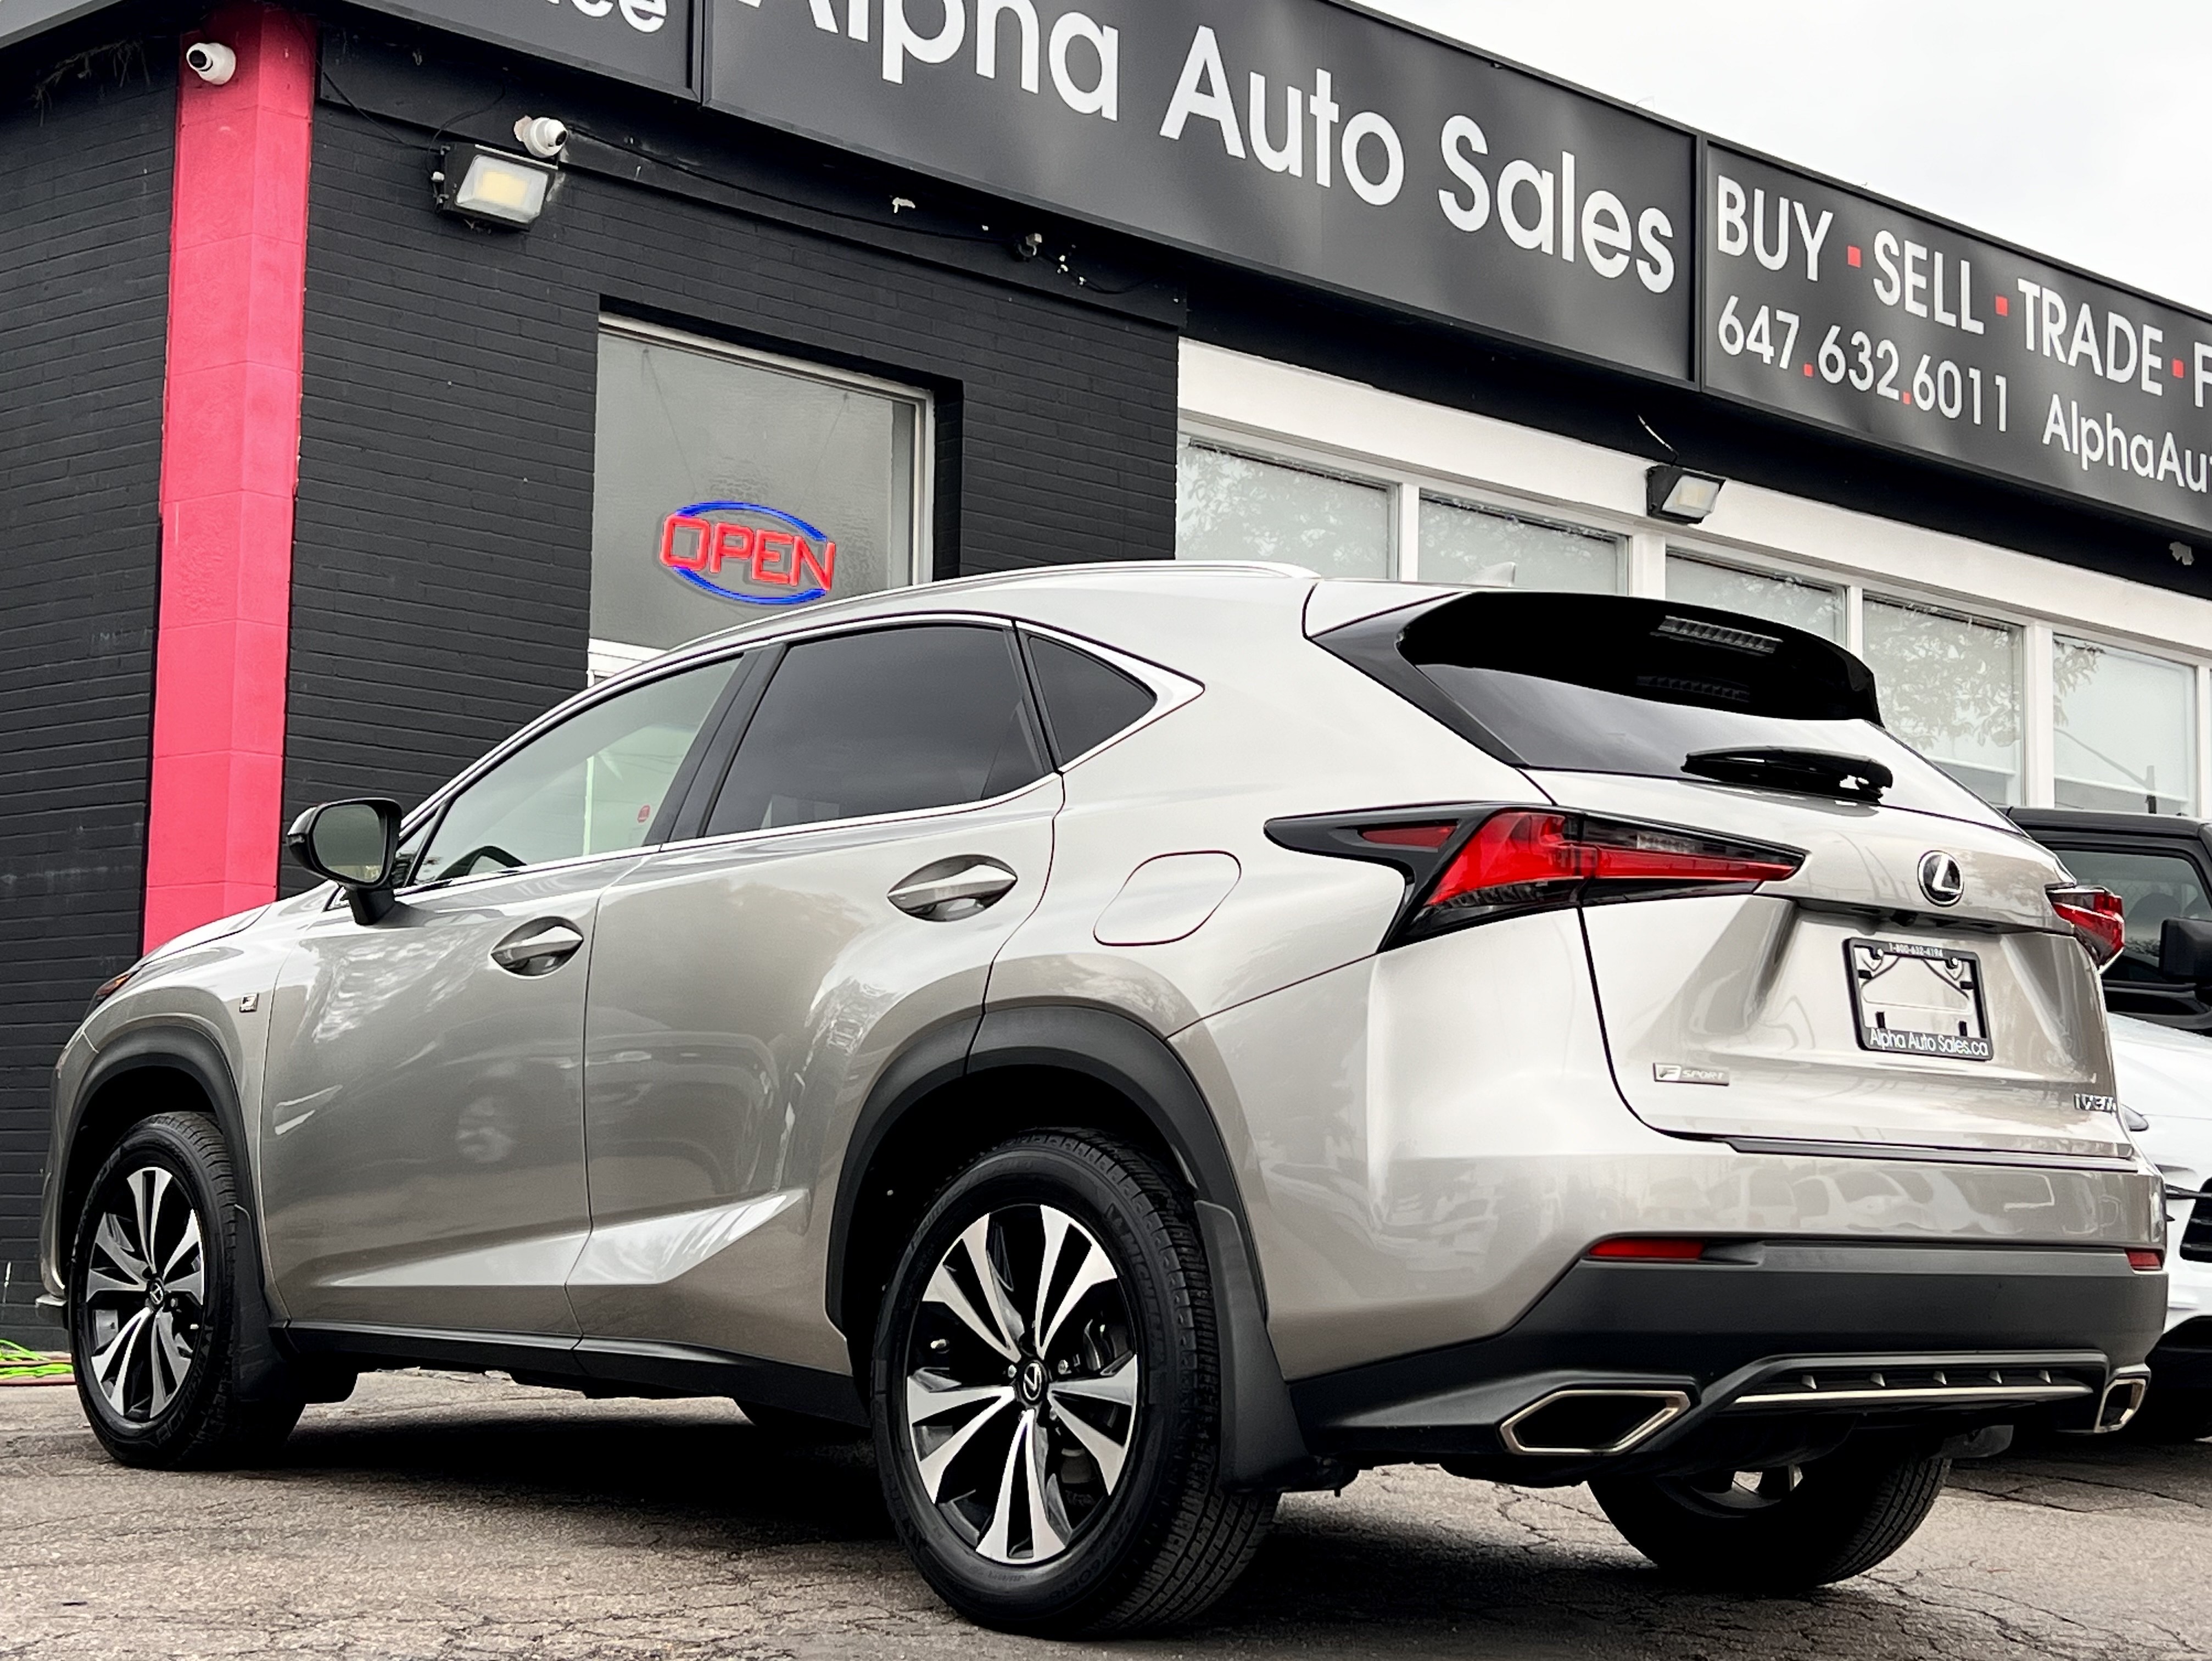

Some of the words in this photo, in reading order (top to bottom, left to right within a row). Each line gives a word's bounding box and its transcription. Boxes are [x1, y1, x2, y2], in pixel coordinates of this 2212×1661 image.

[737, 0, 1118, 122] pha
[1160, 24, 1405, 207] Auto
[1438, 114, 1675, 294] Sales
[1718, 175, 1834, 282] BUY
[1873, 229, 1985, 335] SELL
[2017, 278, 2164, 397] TRADE
[1718, 294, 2007, 432] 647.632.6011
[2042, 393, 2212, 493] AlphaAu
[660, 513, 836, 591] OPEN
[1870, 1027, 1906, 1050] Alpha
[1908, 1031, 1936, 1052] Auto
[1938, 1035, 1989, 1056] Sales.ca
